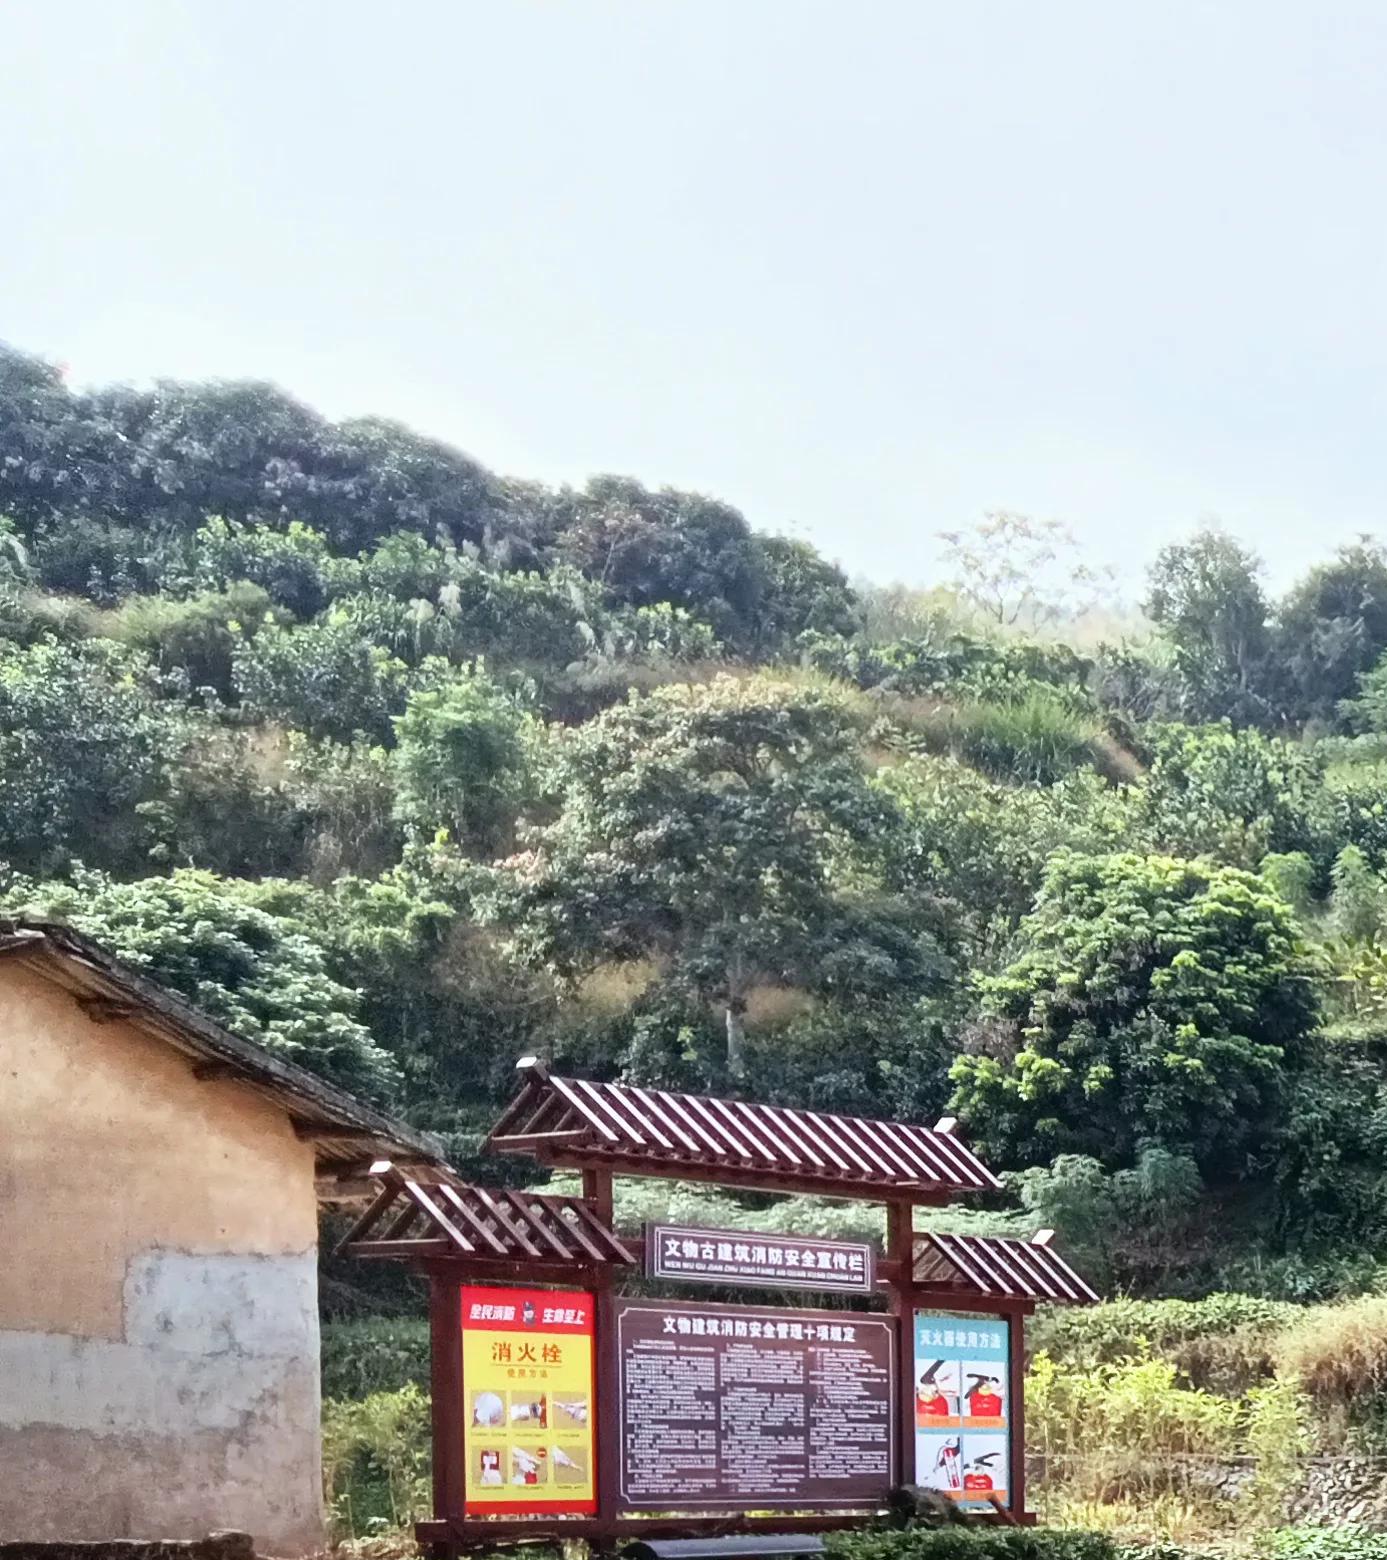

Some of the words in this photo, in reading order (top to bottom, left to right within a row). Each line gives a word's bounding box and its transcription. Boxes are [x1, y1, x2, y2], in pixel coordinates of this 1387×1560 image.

[664, 1238, 864, 1272] 文物古建筑消防安全宣传栏
[663, 1315, 856, 1342] 文物建筑消防安全管理十项规定
[919, 1329, 1001, 1349] 灭火器使用方法
[491, 1341, 562, 1363] 消火栓
